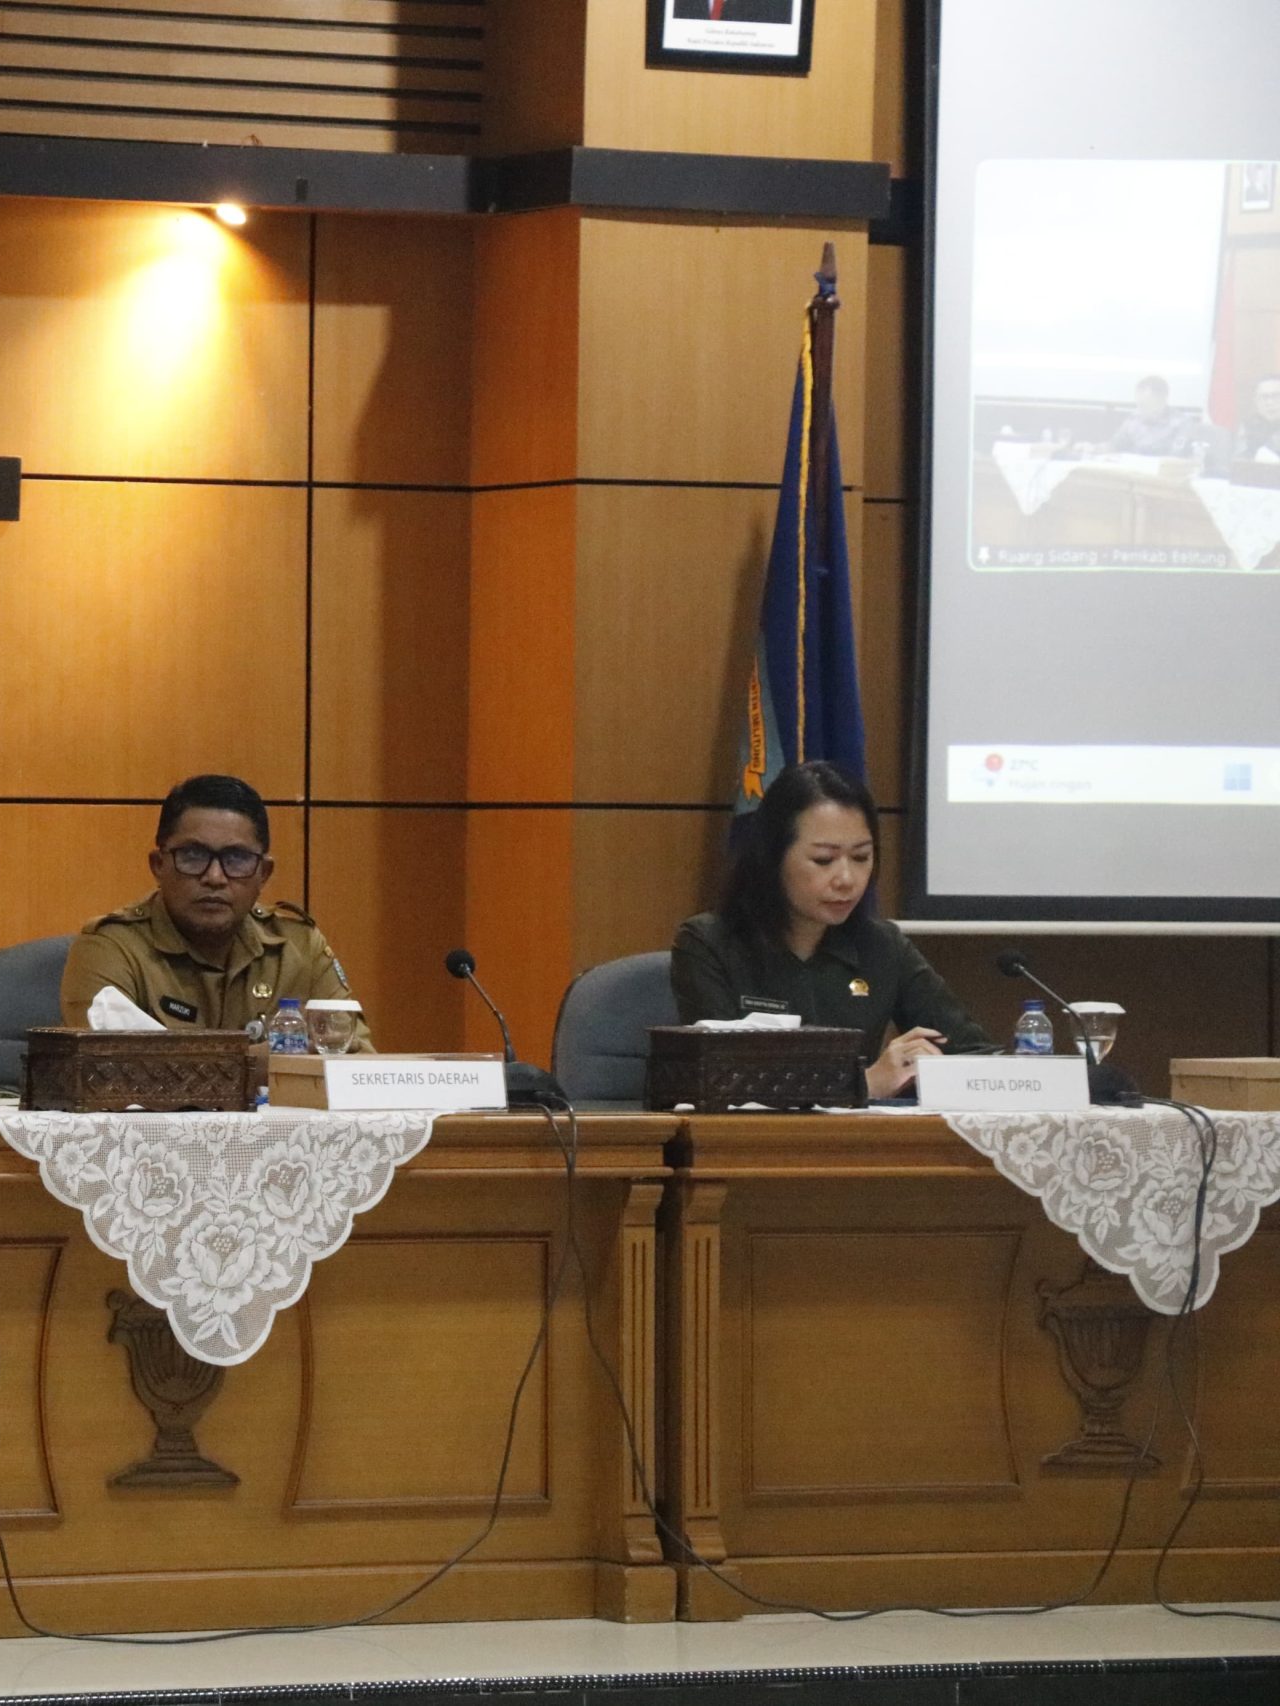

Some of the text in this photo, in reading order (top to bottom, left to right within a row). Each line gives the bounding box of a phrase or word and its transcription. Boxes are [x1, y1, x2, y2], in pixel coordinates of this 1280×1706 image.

[351, 1073, 479, 1085] SEKRETARIS DAERAH
[966, 1079, 1042, 1092] KETUA DPRD
